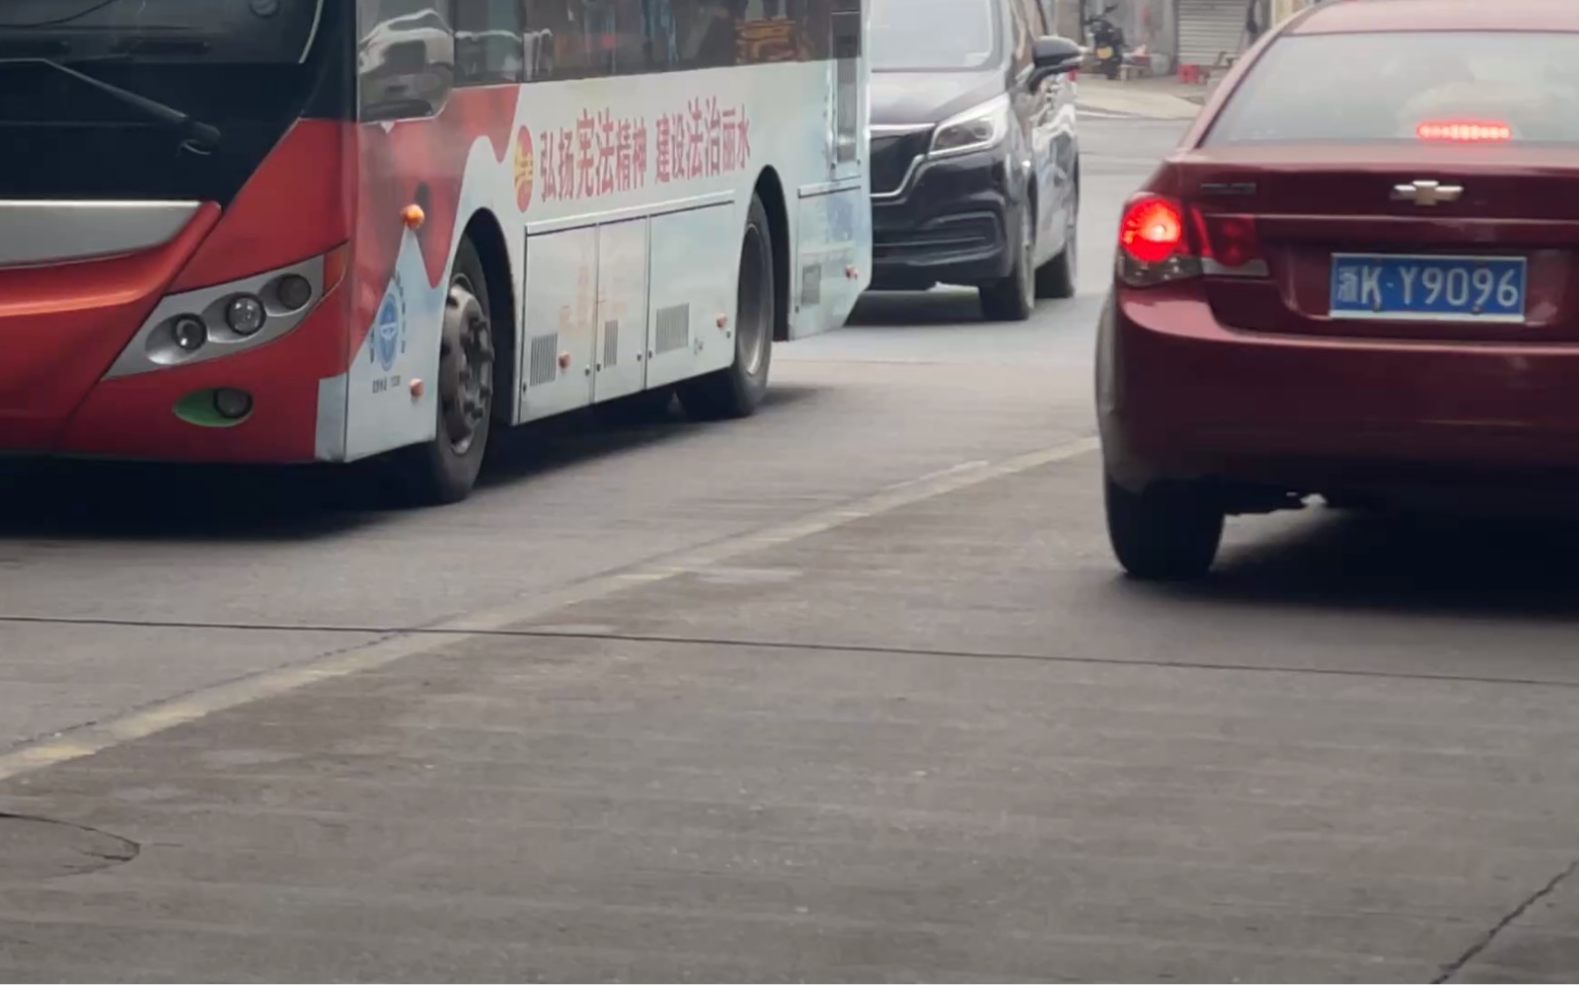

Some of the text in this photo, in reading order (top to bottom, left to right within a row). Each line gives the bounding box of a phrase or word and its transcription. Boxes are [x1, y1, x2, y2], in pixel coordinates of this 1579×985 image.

[539, 96, 751, 202] 弘扬宪法精神 建设法治丽水
